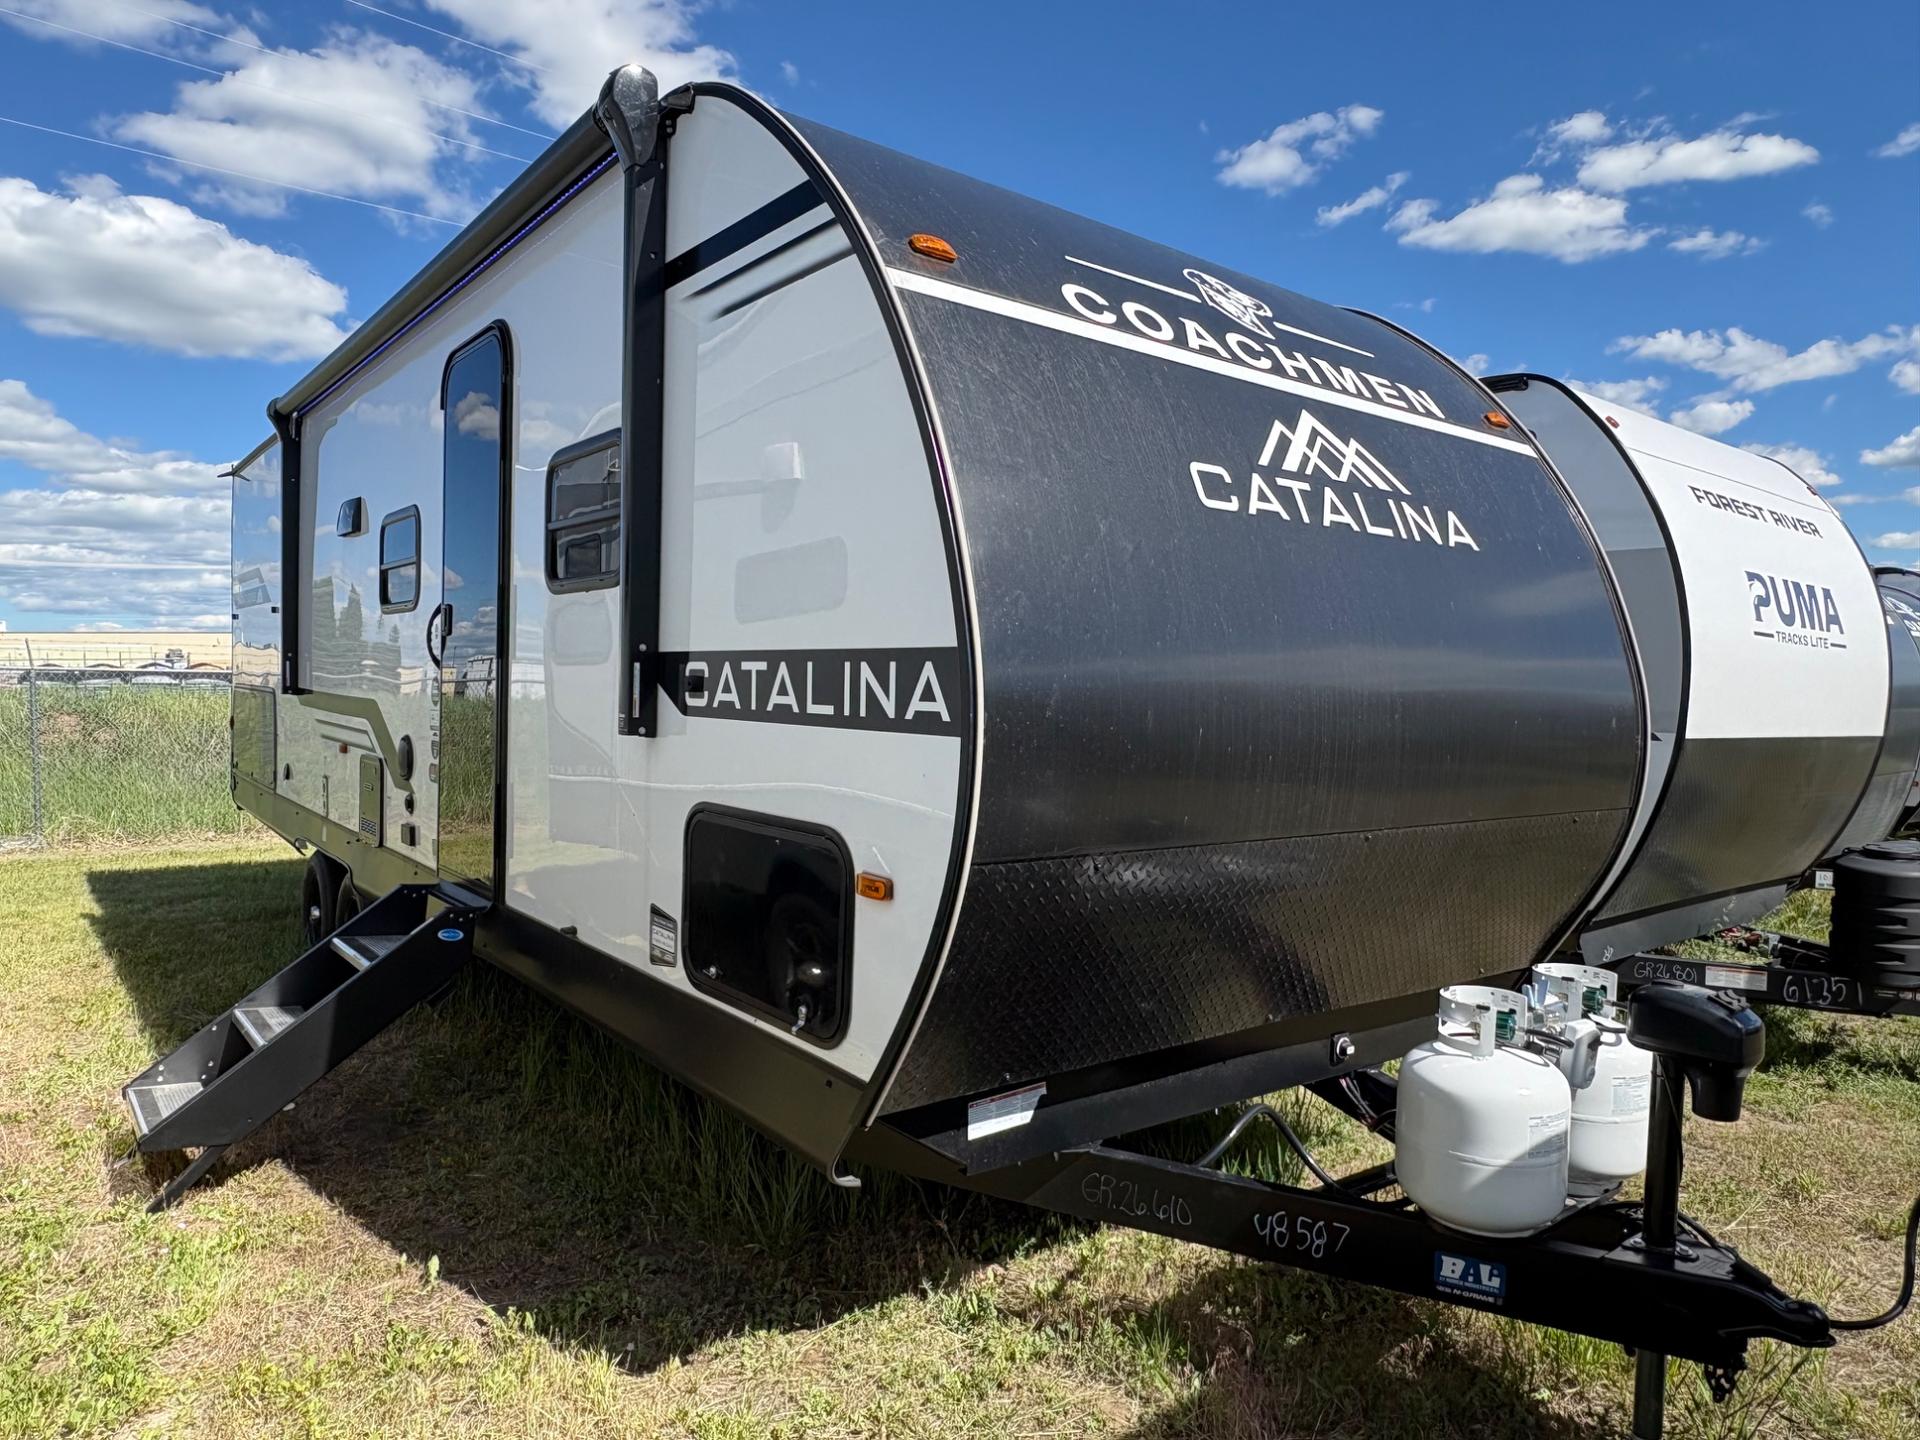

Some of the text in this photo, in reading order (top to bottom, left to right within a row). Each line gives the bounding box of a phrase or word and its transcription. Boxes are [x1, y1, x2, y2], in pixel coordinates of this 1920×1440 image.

[1061, 283, 1446, 420] COACHMEN
[1189, 461, 1481, 552] CATALINA
[1688, 485, 1823, 539] FOREST RIVER
[1745, 570, 1845, 635] PUMA
[1775, 630, 1830, 650] TRACKS LITE
[684, 660, 952, 723] CATALINA
